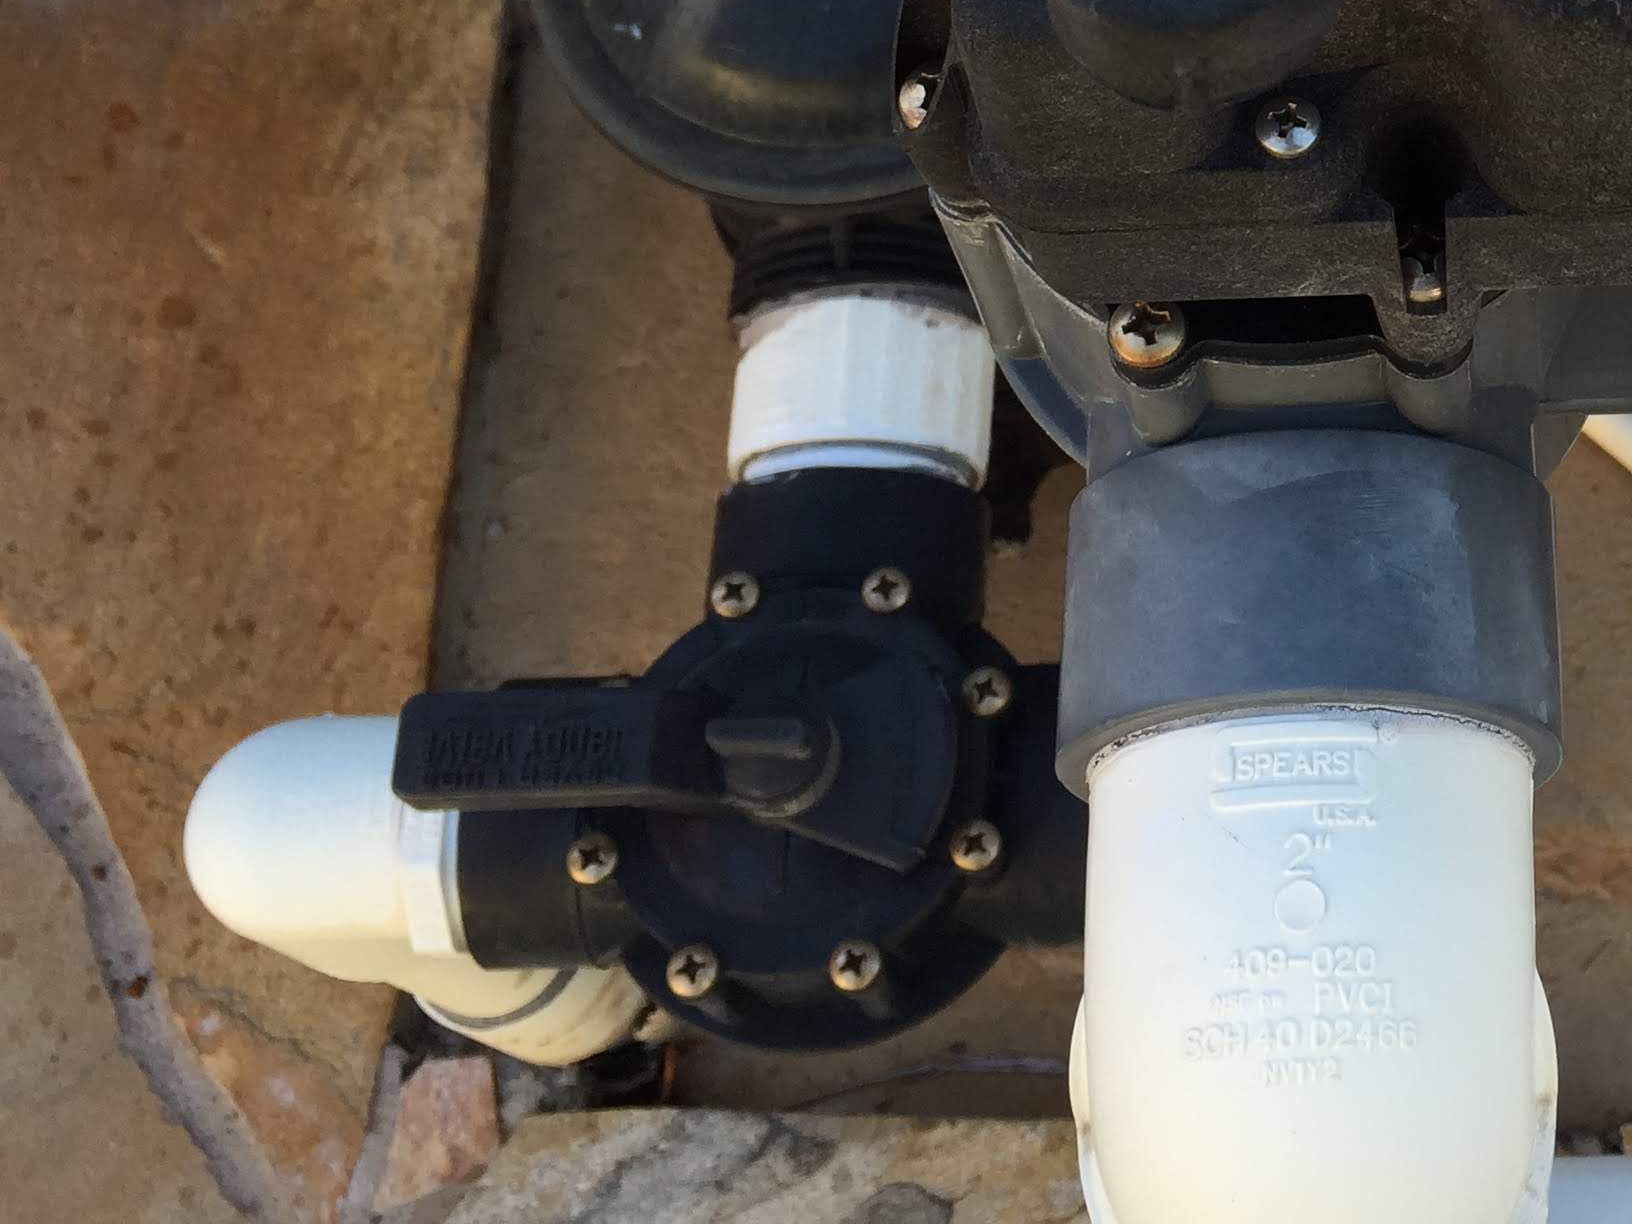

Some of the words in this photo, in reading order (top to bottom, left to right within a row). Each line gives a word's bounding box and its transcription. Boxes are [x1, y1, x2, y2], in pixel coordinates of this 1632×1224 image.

[1236, 750, 1350, 779] SPEARS
[1182, 1023, 1249, 1062] SCH
[1307, 1018, 1419, 1052] D2466
